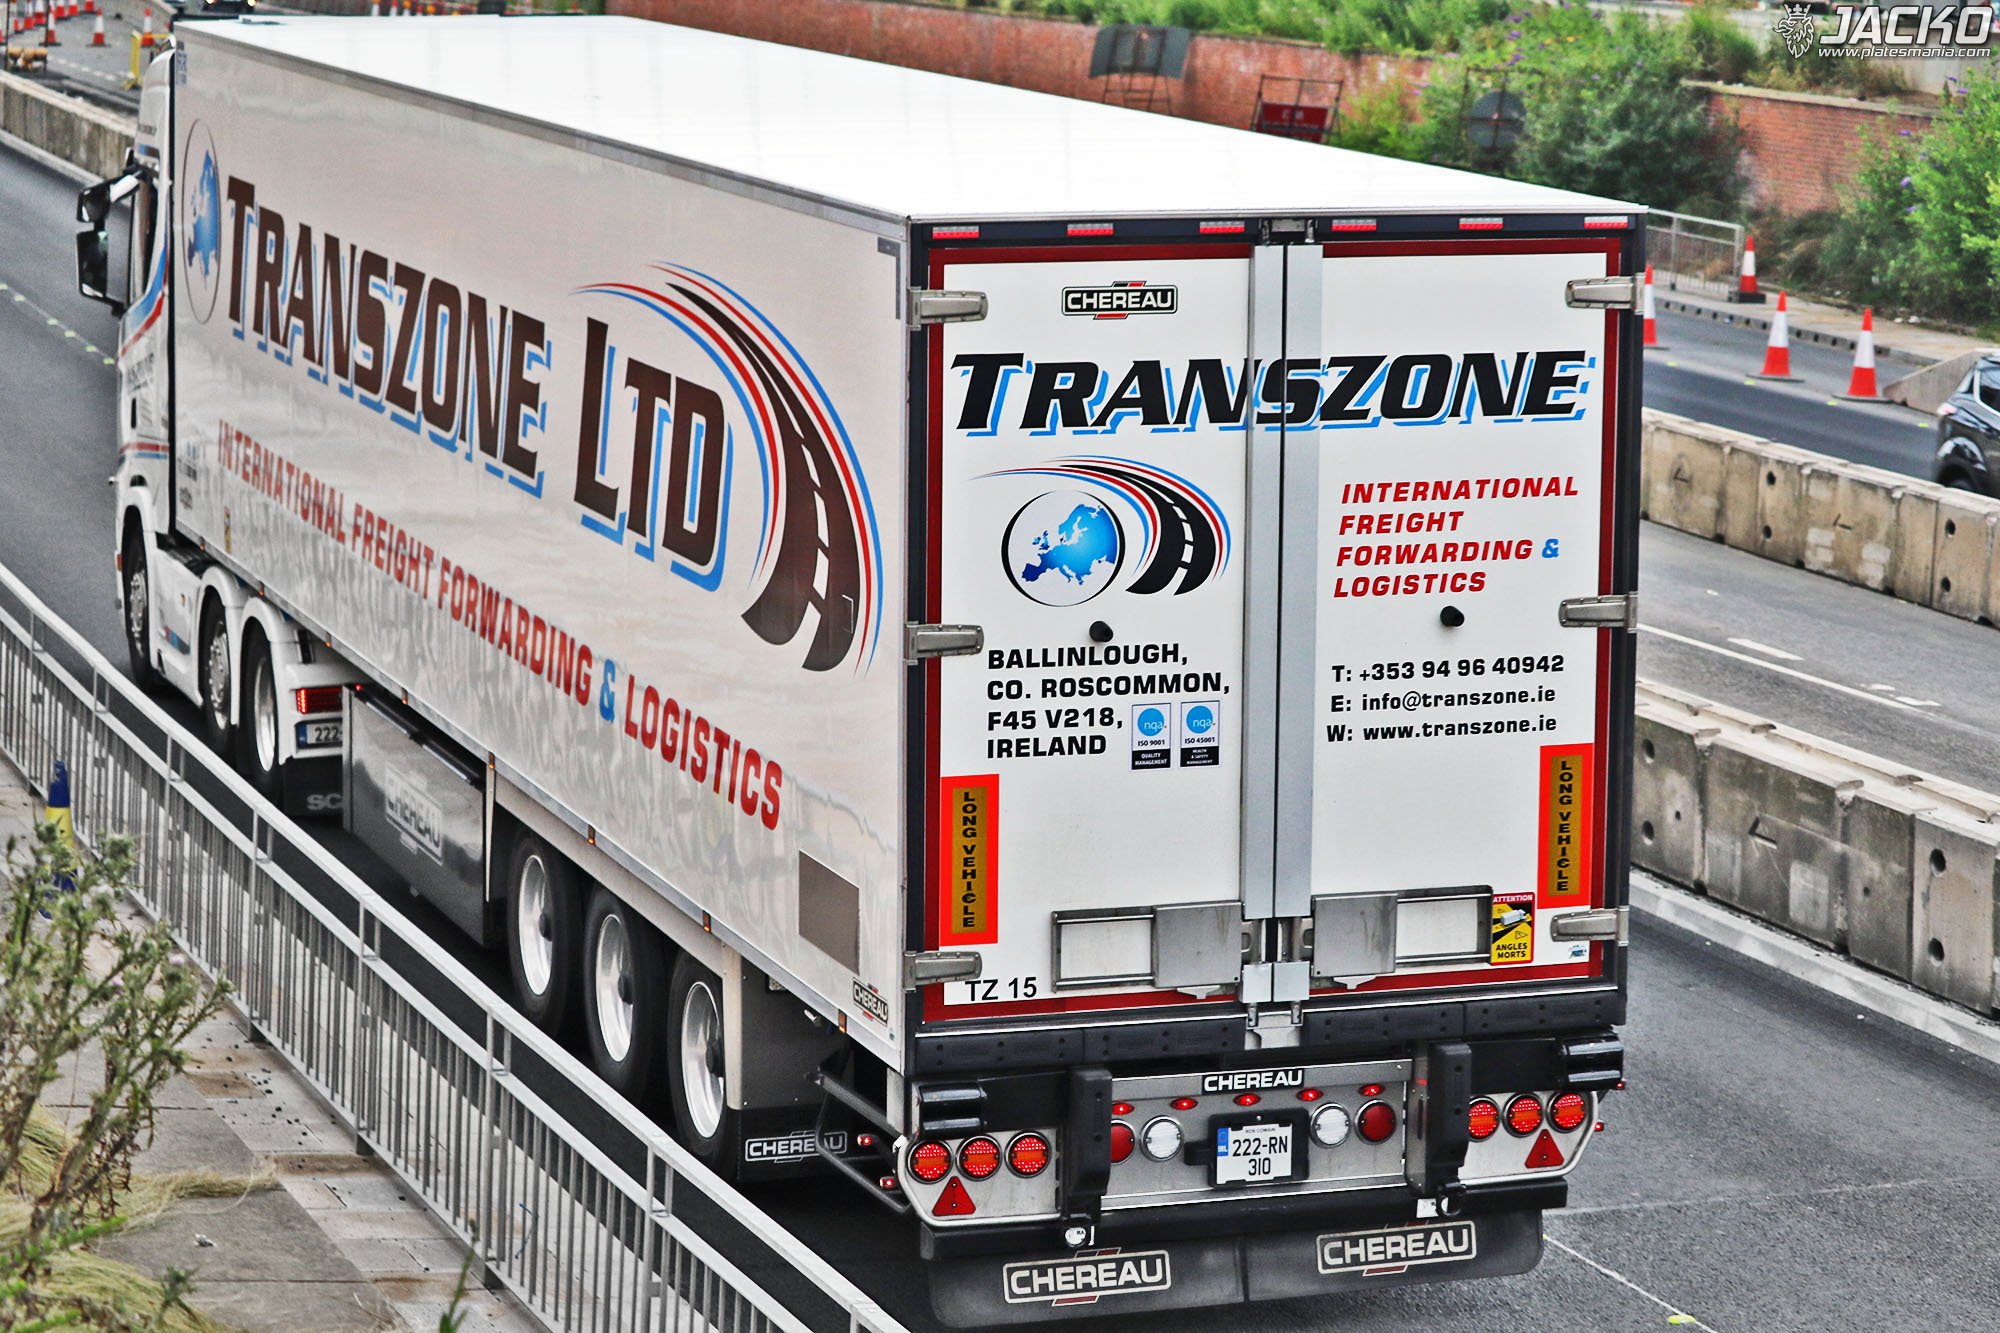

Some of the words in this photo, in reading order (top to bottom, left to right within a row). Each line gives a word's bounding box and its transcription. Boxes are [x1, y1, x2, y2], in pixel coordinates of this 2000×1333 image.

[1067, 291, 1172, 310] CHEREAU
[227, 175, 551, 498] TRANSZONE
[574, 316, 733, 592] LTD
[950, 350, 1597, 437] TRANSZONE
[1341, 476, 1578, 504] INTERNATIONAL
[1338, 511, 1464, 535] FREIGHT
[1336, 539, 1533, 567] FORWARDING
[1541, 538, 1559, 558] &
[1334, 571, 1486, 598] LOGISTICS
[218, 420, 346, 543] INTERNATIONAL
[353, 504, 434, 600] FREIGHT
[438, 557, 593, 706] FORWARDING
[599, 659, 617, 723] &
[624, 674, 784, 830] LOGISTICS
[988, 643, 1188, 669] BALLINLOUGH,
[1332, 665, 1351, 682] T:
[1359, 662, 1415, 681] +353
[1422, 660, 1450, 678] 94
[1457, 659, 1485, 677] 96
[1492, 655, 1564, 674] 40942
[987, 679, 1031, 700] CO.
[1041, 672, 1230, 699] ROSCOMMON,
[1331, 695, 1351, 712] E:
[1362, 685, 1556, 712] info@transzone.ie
[988, 710, 1037, 731] F45
[1045, 707, 1123, 729] V218,
[1327, 725, 1353, 742] W:
[1363, 714, 1557, 740] www.transzone.ie
[987, 735, 1107, 759] IRELAND
[1558, 761, 1573, 805] LONG
[962, 791, 977, 838] LONG
[1557, 811, 1572, 891] VEHICLE
[962, 845, 976, 928] VEHICLE
[1492, 895, 1533, 903] ATTENTION
[1496, 943, 1528, 951] ANGLES
[1497, 951, 1526, 959] MORTS
[853, 981, 888, 1022] CHEREAU
[965, 979, 999, 1001] TZ
[1008, 977, 1037, 998] 15
[1204, 1070, 1302, 1092] CHEREAU
[1233, 1136, 1287, 1157] 222-RN
[1322, 1226, 1470, 1266] CHEREAU
[1009, 1257, 1164, 1295] CHEREAU
